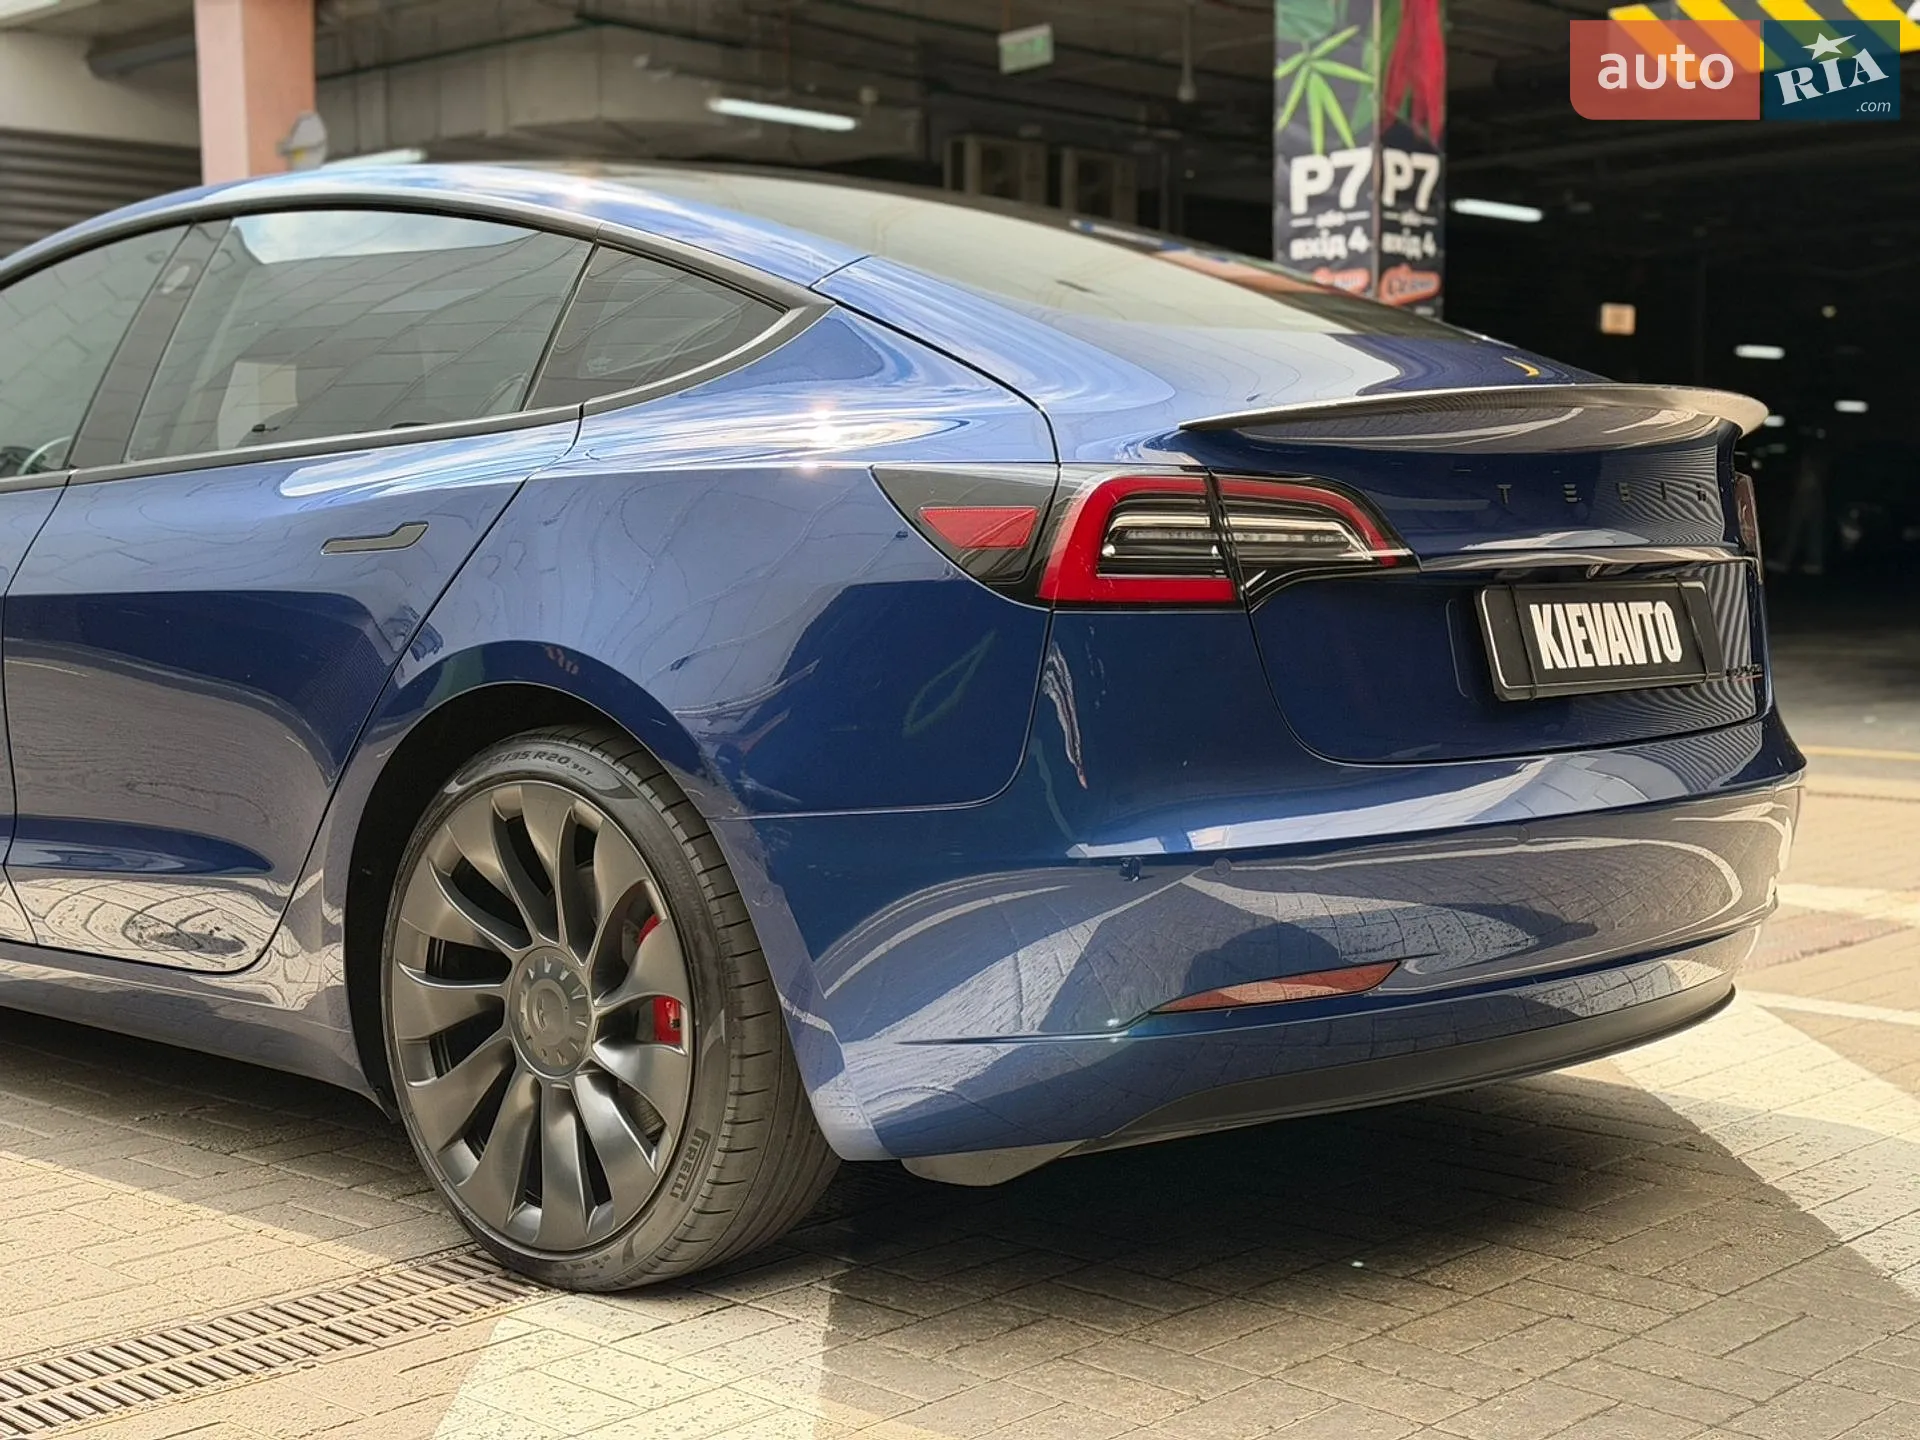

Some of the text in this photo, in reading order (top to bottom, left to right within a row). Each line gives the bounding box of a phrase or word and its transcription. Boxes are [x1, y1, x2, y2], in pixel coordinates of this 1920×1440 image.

[1290, 147, 1373, 215] P7
[1382, 149, 1440, 212] P7
[1348, 226, 1370, 253] 4
[1529, 600, 1683, 670] KIEVAVTO
[532, 751, 571, 765] R20
[669, 1127, 711, 1202] PIRELLI
